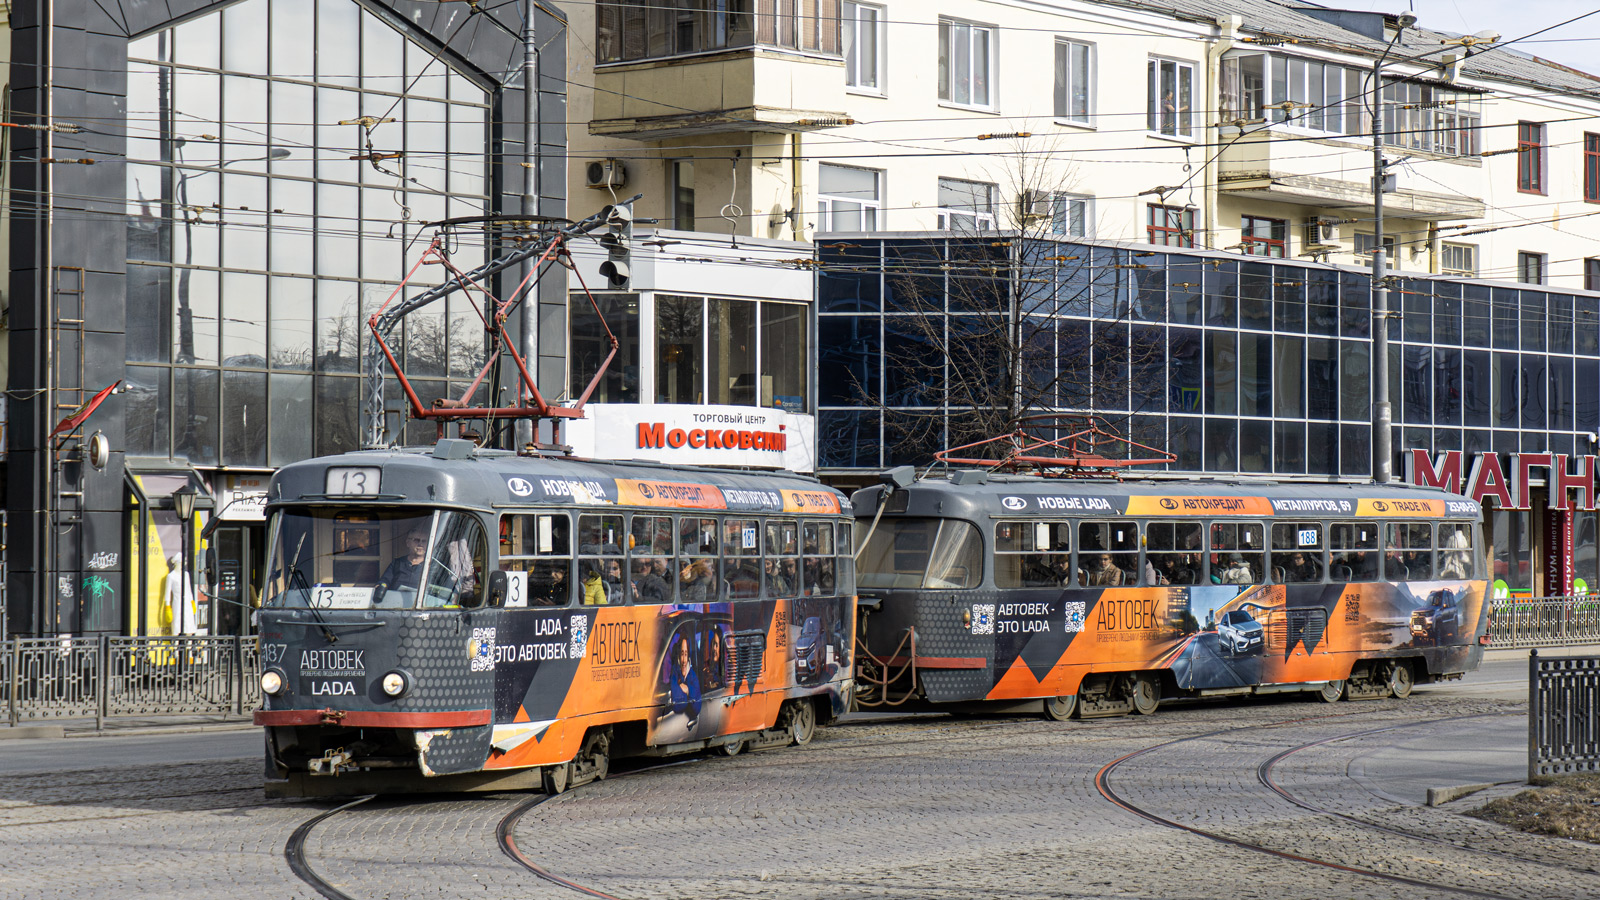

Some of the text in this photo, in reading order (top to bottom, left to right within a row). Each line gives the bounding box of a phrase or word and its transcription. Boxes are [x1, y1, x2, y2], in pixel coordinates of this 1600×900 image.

[693, 413, 766, 425] ТОРГОВЫЙ ЦЕНТР
[342, 470, 366, 494] 13
[1411, 448, 1600, 510] МАГН
[656, 485, 706, 503] АВТОКРЕДИТ
[804, 493, 824, 507] TRADE
[823, 494, 834, 507] IN
[1036, 497, 1112, 510] НОВЫЕ LADA
[1183, 498, 1246, 511] АВТОКРЕДИТ
[1272, 499, 1352, 513] МЕТАЛЛУРГОВ, 69
[1392, 501, 1432, 512] TRADE IN
[743, 529, 756, 547] 187
[1300, 531, 1316, 545] 188
[316, 589, 334, 608] 13
[998, 603, 1049, 616] АВТОВЕК
[1097, 600, 1159, 630] АВТОВЕК
[535, 618, 562, 636] LADA
[997, 620, 1050, 633] ЭТО LADA
[591, 620, 642, 666] АВТОВЕК
[262, 643, 287, 663] 187
[300, 650, 365, 669] АВТОВЕК
[495, 642, 567, 663] ЭТО АВТОВЕК
[311, 681, 356, 696] LADA
